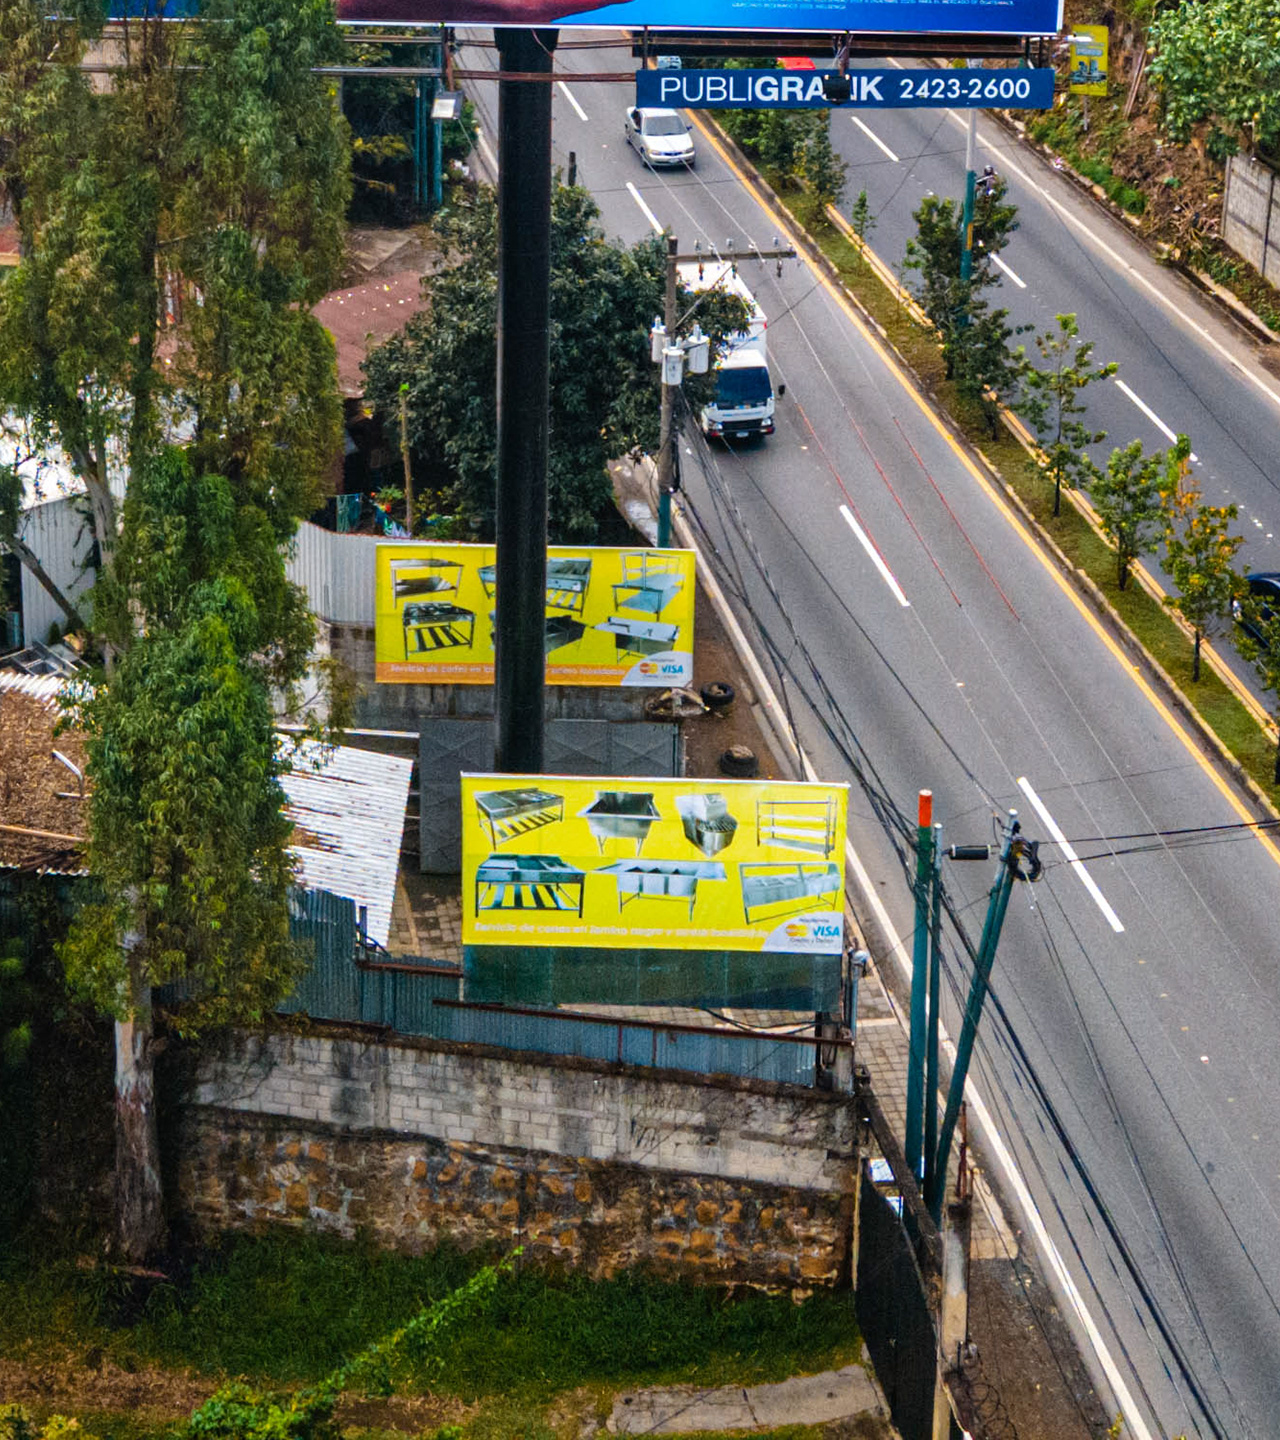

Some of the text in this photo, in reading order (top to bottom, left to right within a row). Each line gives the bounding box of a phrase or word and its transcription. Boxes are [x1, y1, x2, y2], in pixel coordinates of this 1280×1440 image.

[661, 75, 1030, 101] PUBLIGRAIK 2423-2600
[662, 665, 683, 673] VISA
[813, 925, 840, 936] VISA
